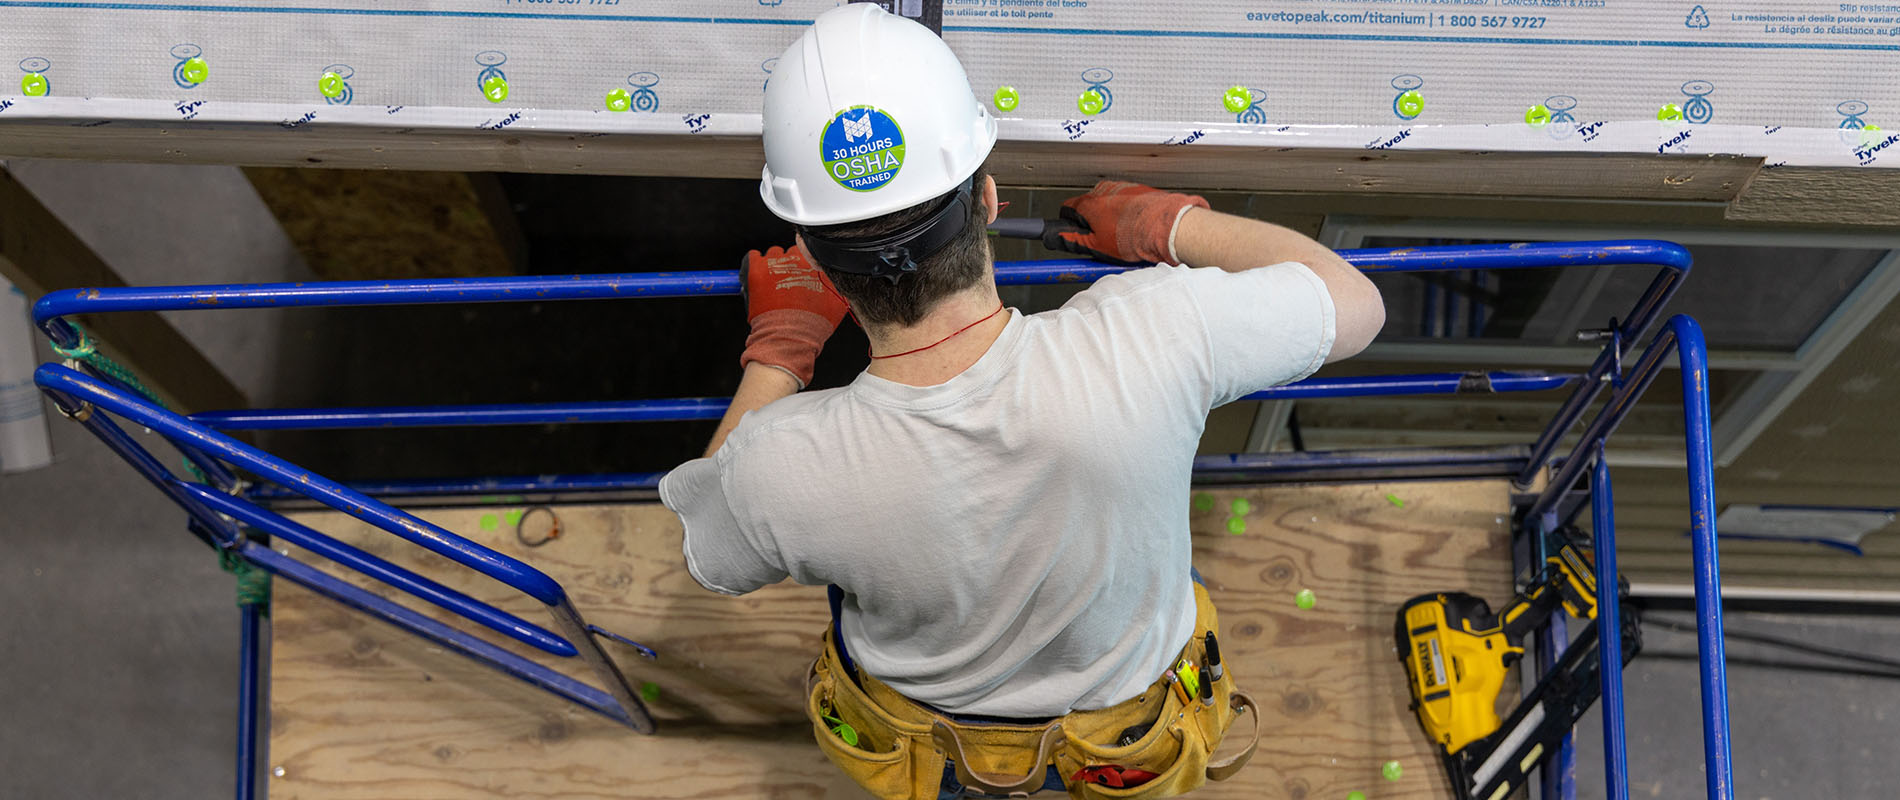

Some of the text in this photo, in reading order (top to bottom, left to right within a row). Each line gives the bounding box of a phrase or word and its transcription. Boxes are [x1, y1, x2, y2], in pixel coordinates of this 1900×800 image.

[1246, 10, 1425, 25] eavetopeak.com/titanium
[1450, 15, 1476, 27] 800
[1481, 16, 1507, 28] 567
[1511, 16, 1546, 29] 9727
[1868, 15, 1894, 23] variar
[685, 114, 710, 128] Tyv
[832, 137, 893, 160] 30 HOURS
[1855, 134, 1900, 160] Tyvek
[833, 150, 900, 179] OSHA
[849, 172, 891, 188] TRAINED
